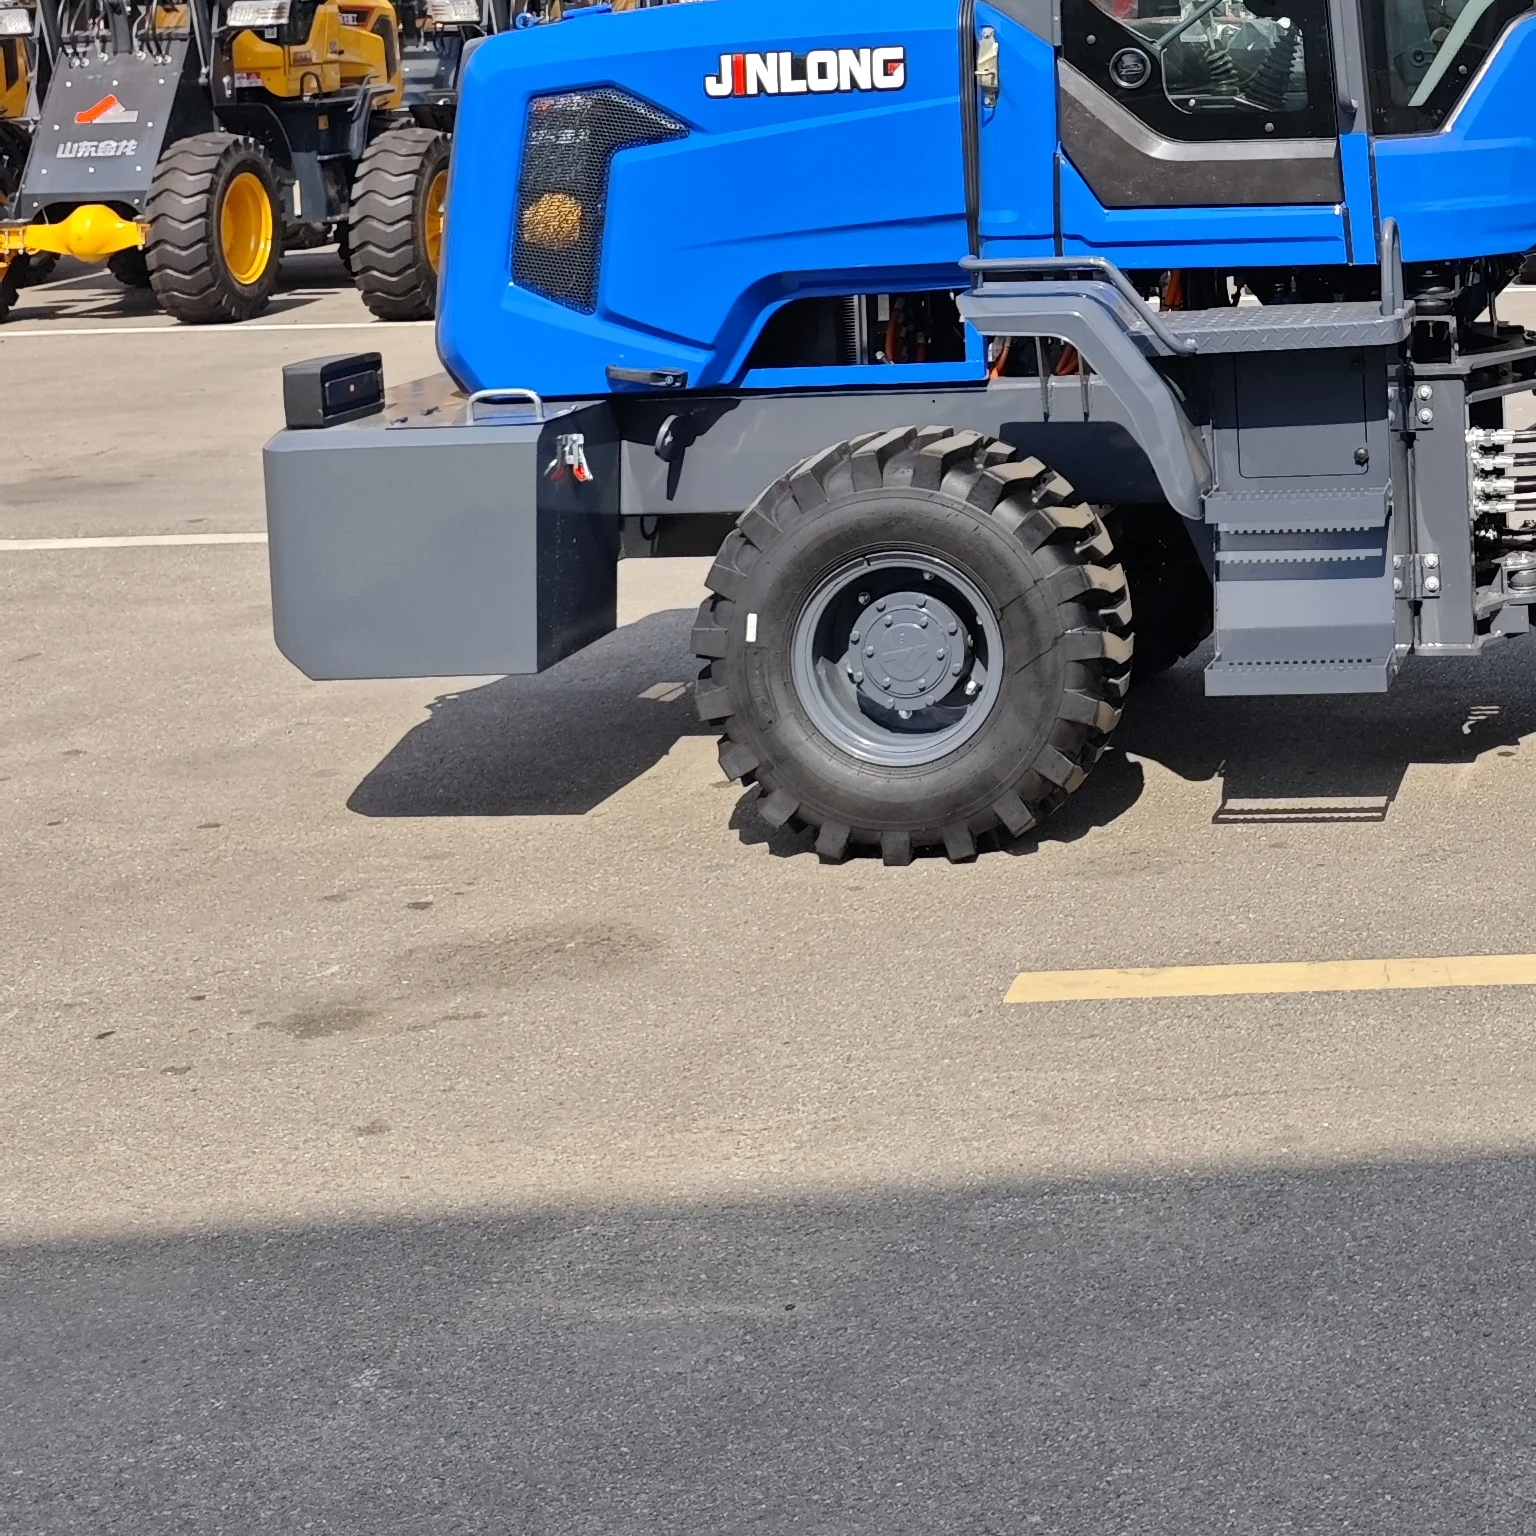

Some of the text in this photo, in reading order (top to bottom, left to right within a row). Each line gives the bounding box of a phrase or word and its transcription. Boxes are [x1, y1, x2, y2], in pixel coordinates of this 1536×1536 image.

[704, 46, 906, 98] JINLONG
[56, 139, 138, 159] 山东金龙
